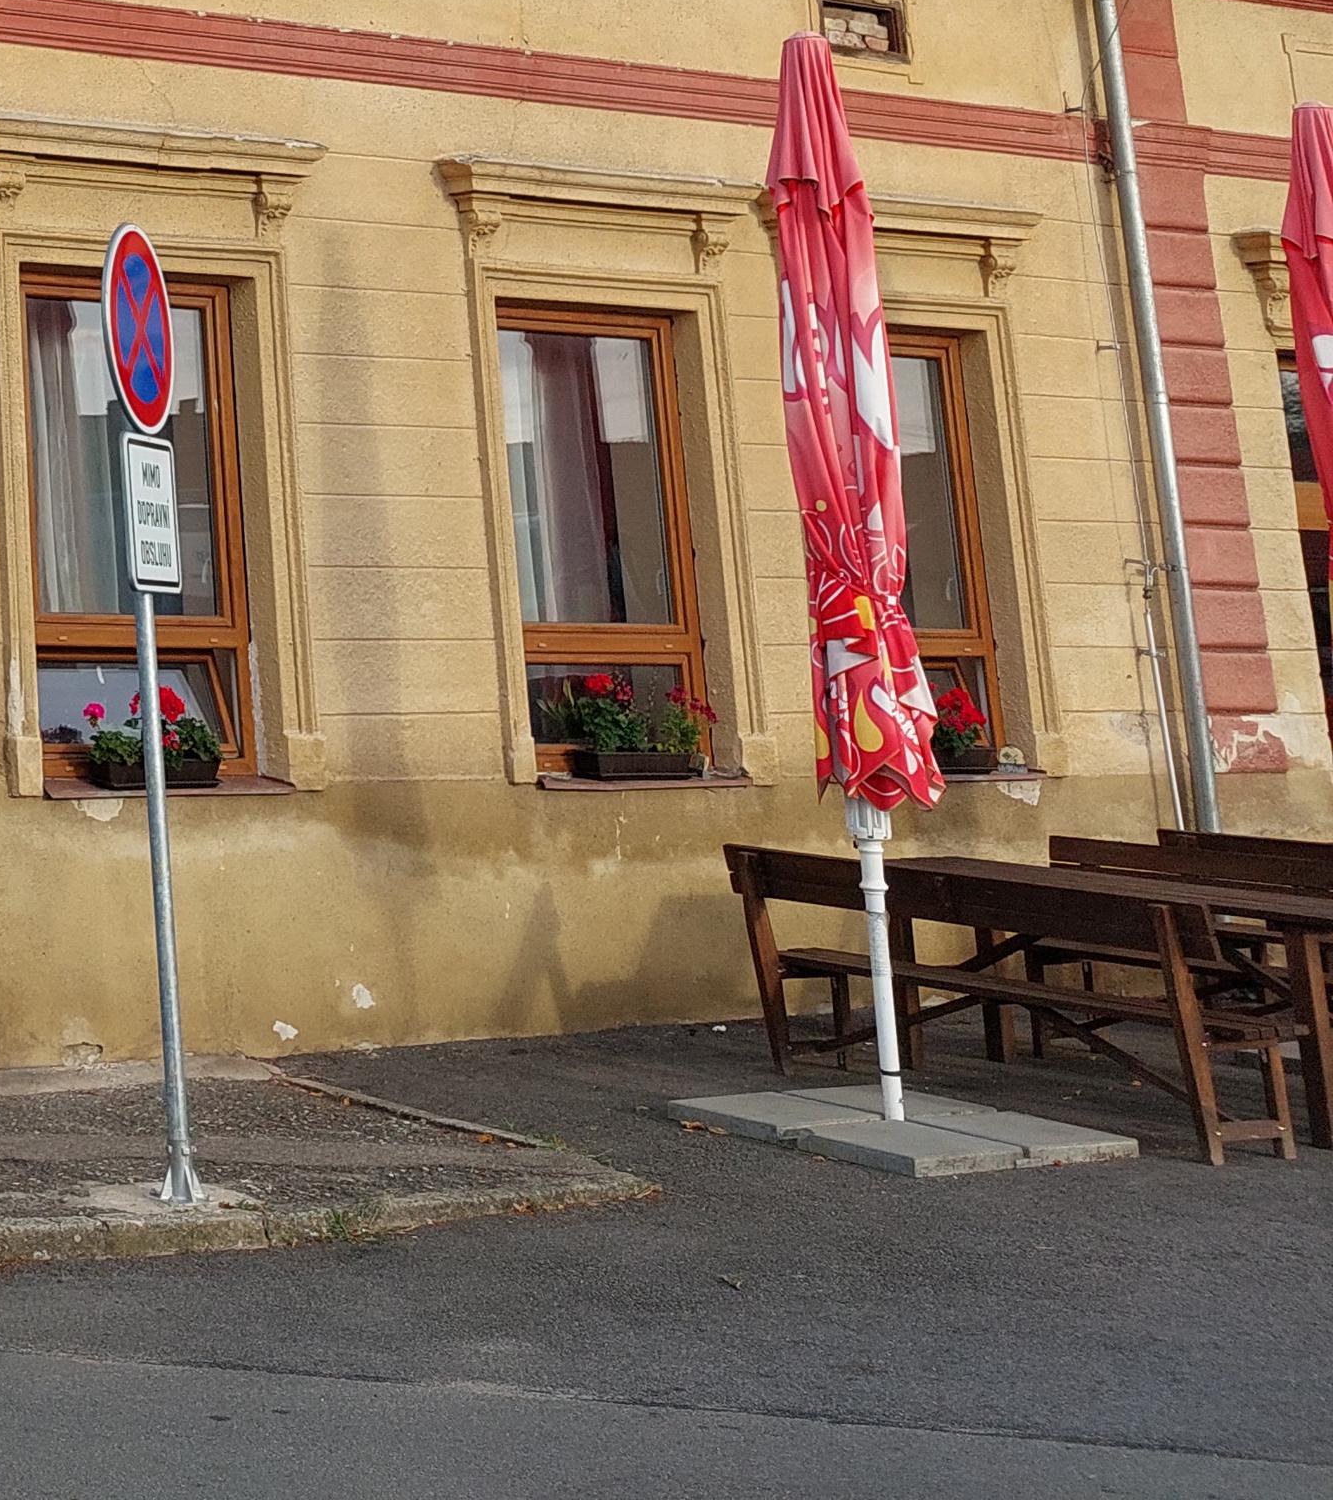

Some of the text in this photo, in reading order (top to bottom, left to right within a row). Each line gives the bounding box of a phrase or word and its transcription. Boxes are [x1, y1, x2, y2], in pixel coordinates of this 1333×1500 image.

[141, 461, 161, 489] MIMO
[137, 497, 171, 529] DOPRAVNÍ
[140, 540, 172, 567] OBSLUHU
